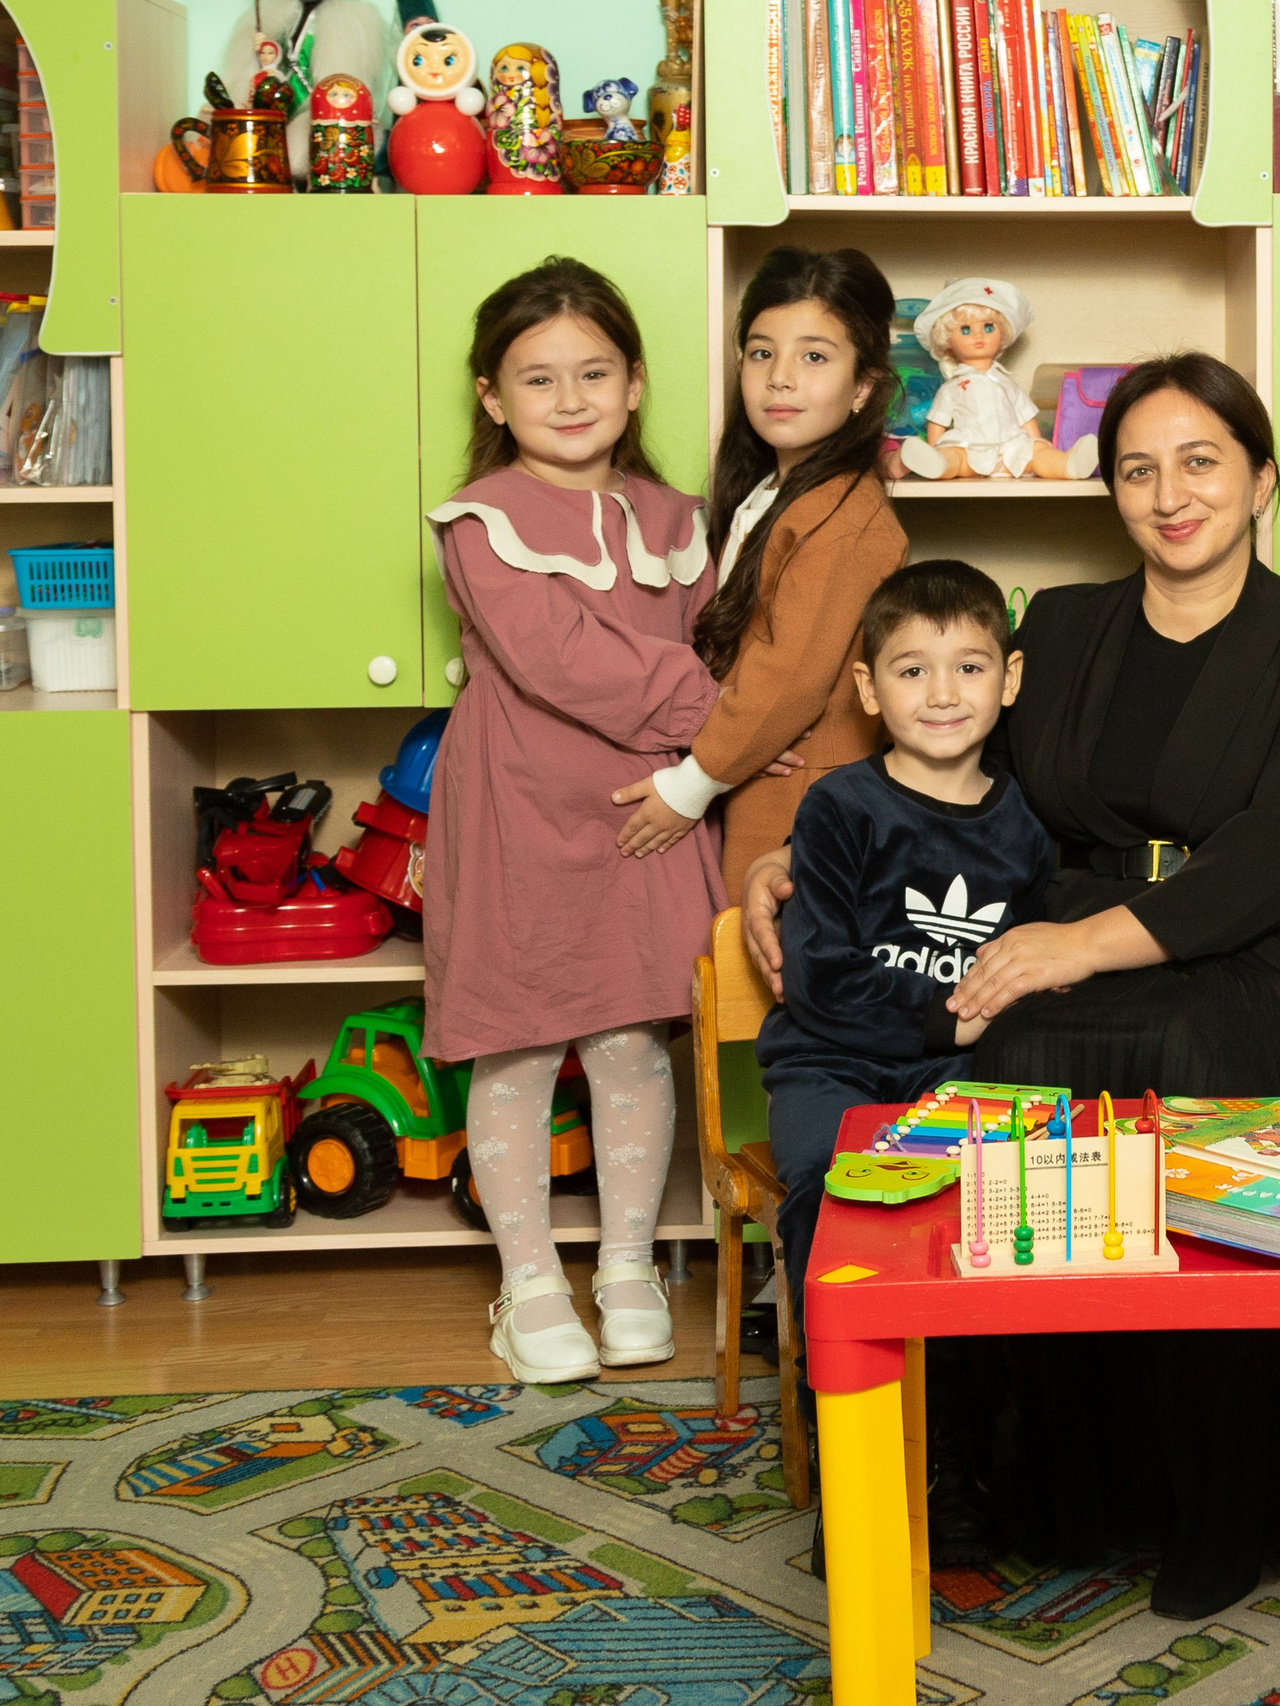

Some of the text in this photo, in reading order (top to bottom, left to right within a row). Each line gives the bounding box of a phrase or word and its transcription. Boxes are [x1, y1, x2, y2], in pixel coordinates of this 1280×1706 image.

[899, 19, 913, 70] СКАЗОК
[979, 37, 990, 73] СКАЗКИ
[903, 75, 912, 87] НА
[955, 6, 979, 164] КРАСНАЯ КНИГА РОССИИ
[851, 28, 867, 186] Редьярд Киплинг Сказки
[905, 90, 914, 129] КРУГЛЫЙ
[906, 131, 915, 148] ГОД
[1103, 138, 1115, 173] БОГАТЫРЬ
[871, 943, 978, 984] adid
[275, 1656, 301, 1681] H
